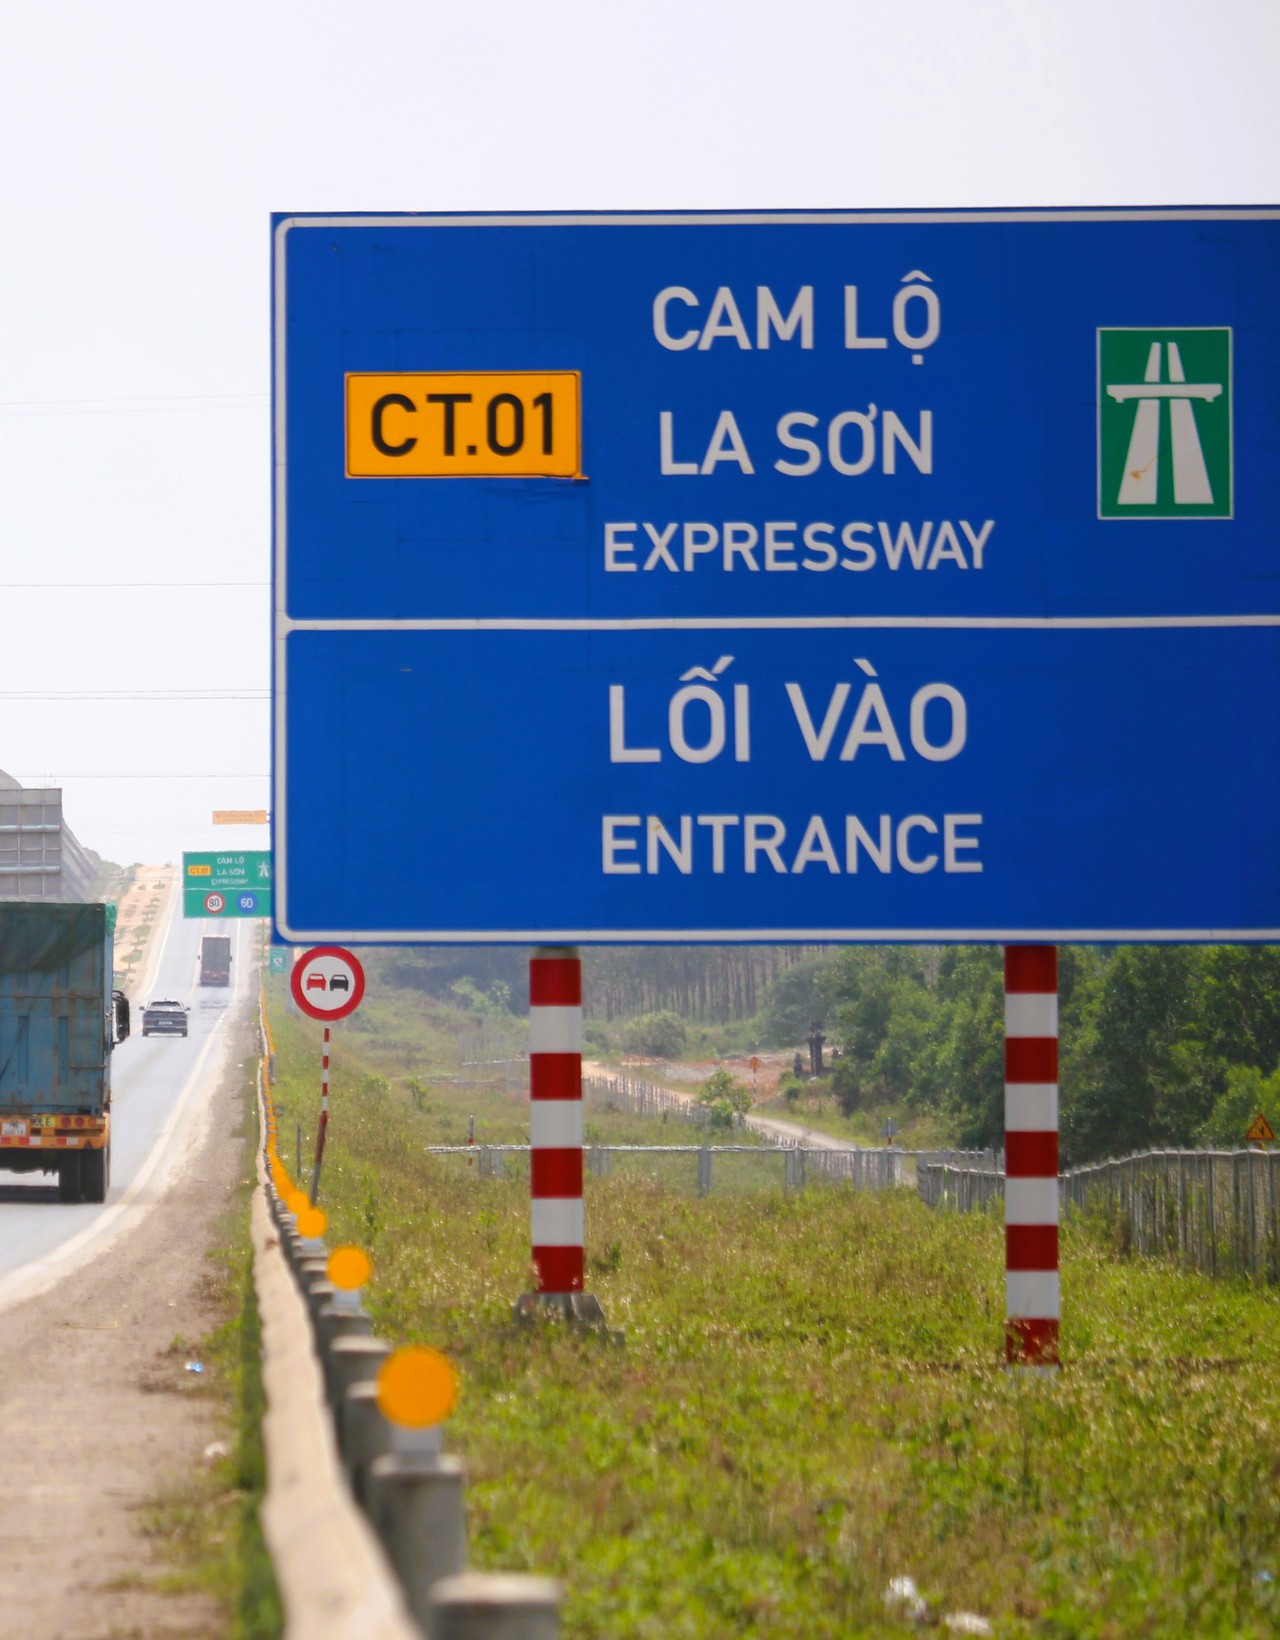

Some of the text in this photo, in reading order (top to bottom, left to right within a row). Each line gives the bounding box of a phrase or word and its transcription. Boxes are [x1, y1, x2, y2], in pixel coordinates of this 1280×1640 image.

[653, 269, 940, 365] CAM LỘ
[371, 392, 554, 457] CT.01
[660, 402, 932, 477] LA SƠN
[604, 519, 995, 572] EXPRESSWAY
[609, 655, 967, 764] LỐI VÀO
[602, 813, 983, 875] ENTRANCE
[209, 898, 220, 908] 80
[240, 898, 253, 908] 60
